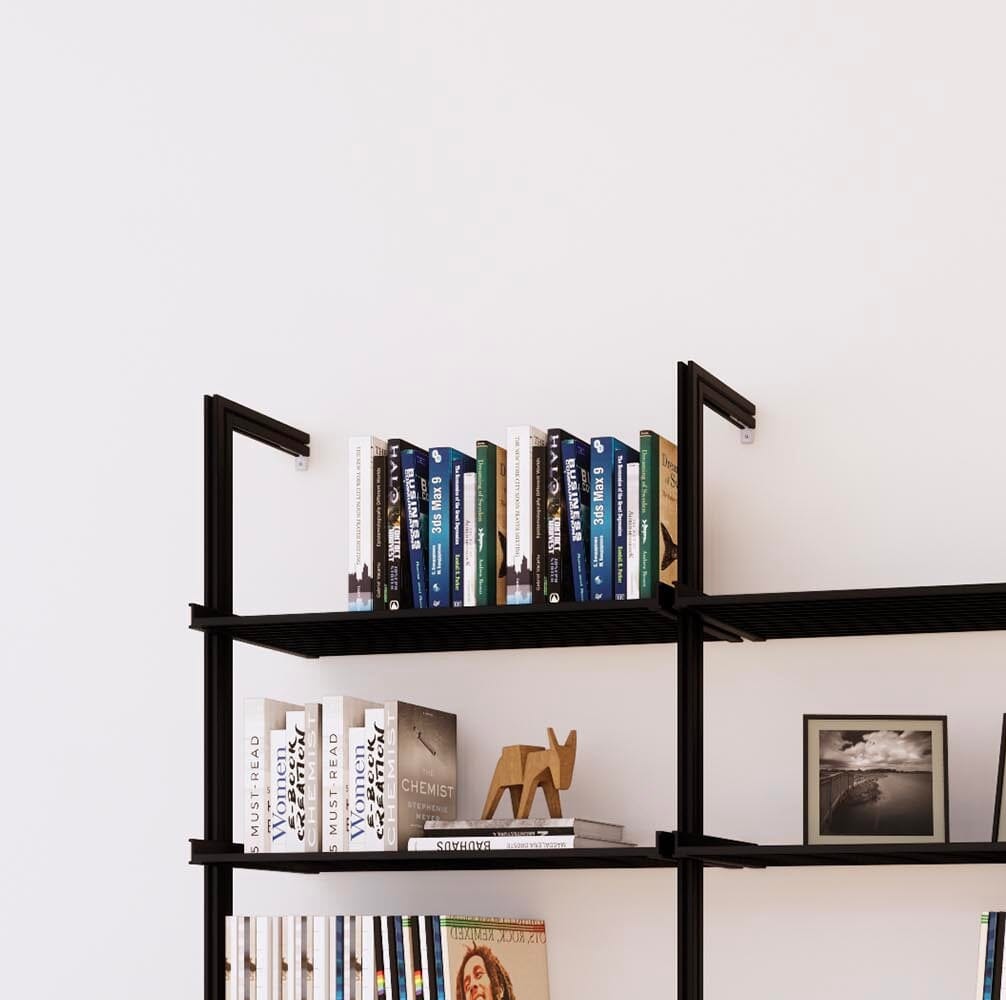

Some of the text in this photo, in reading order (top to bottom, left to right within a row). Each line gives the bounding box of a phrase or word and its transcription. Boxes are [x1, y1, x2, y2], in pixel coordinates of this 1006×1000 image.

[388, 444, 399, 505] HALO
[431, 476, 442, 484] 9
[431, 487, 442, 511] Max
[549, 434, 560, 496] HALO
[593, 467, 604, 475] 9
[593, 477, 604, 501] Max
[431, 513, 442, 534] 3ds
[593, 505, 604, 525] 3ds
[251, 735, 260, 837] MUST-READ
[272, 746, 287, 841] Women
[288, 736, 298, 830] E-BOOK
[295, 723, 306, 841] CREATION
[308, 717, 317, 847] CHEMIST
[329, 733, 338, 836] MUST-READ
[350, 745, 365, 841] Women
[366, 734, 376, 829] E-BOOK
[373, 720, 385, 840] CREATION
[387, 714, 396, 846] CHEMIST
[401, 778, 454, 799] CHEMIST
[436, 840, 491, 851] BAUHAUS
